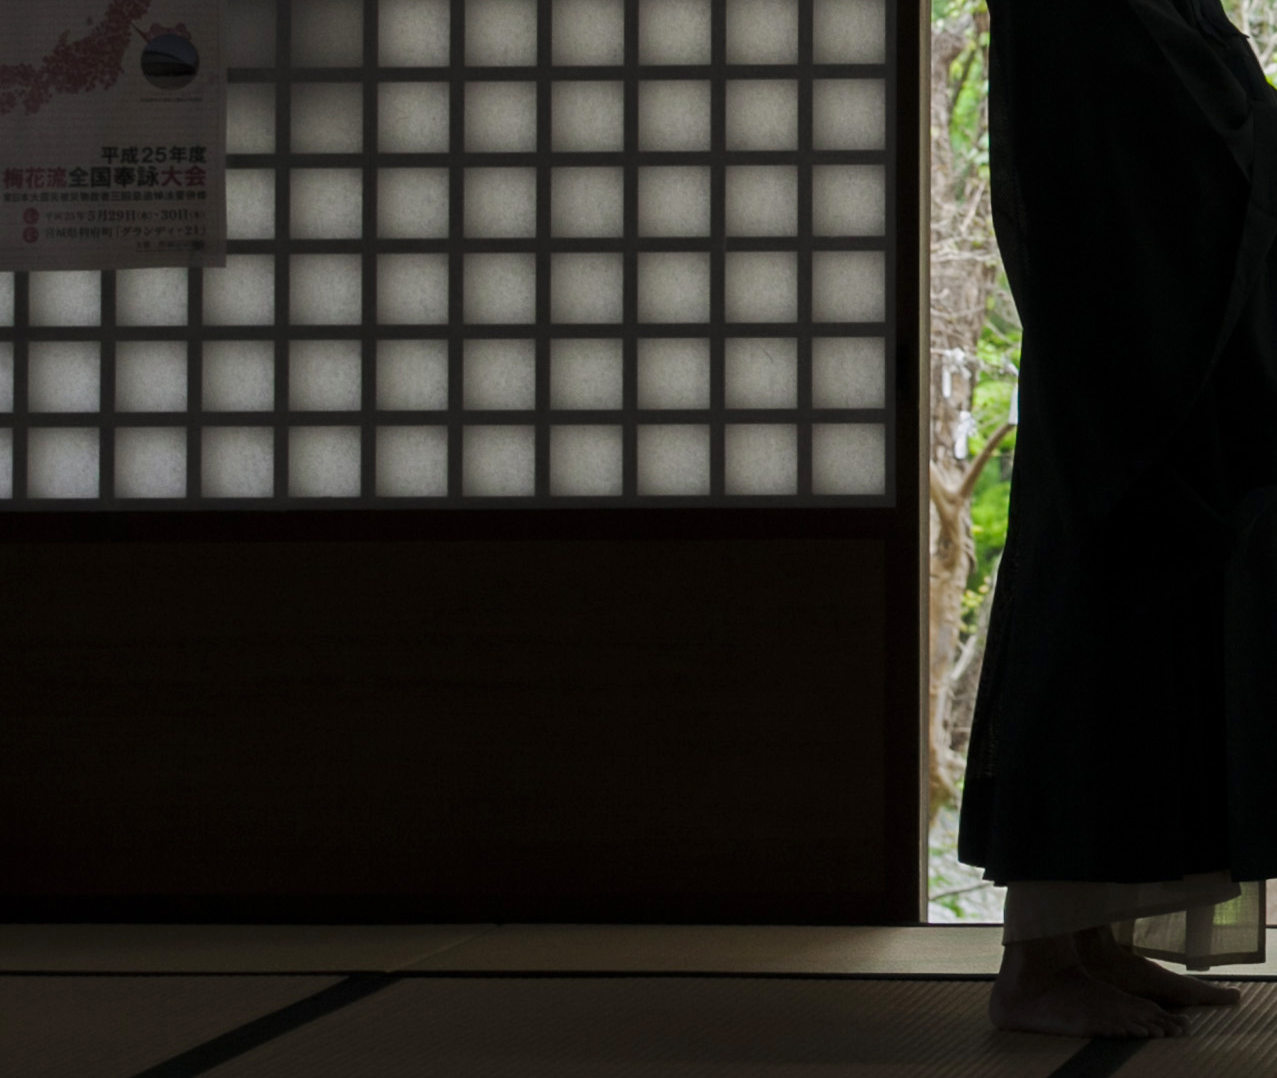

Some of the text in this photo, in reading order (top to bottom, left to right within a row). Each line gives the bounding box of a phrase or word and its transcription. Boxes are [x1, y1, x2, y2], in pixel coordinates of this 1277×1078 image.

[101, 146, 207, 164] 平成25年度
[3, 165, 207, 189] 梅花流全国奉詠大会
